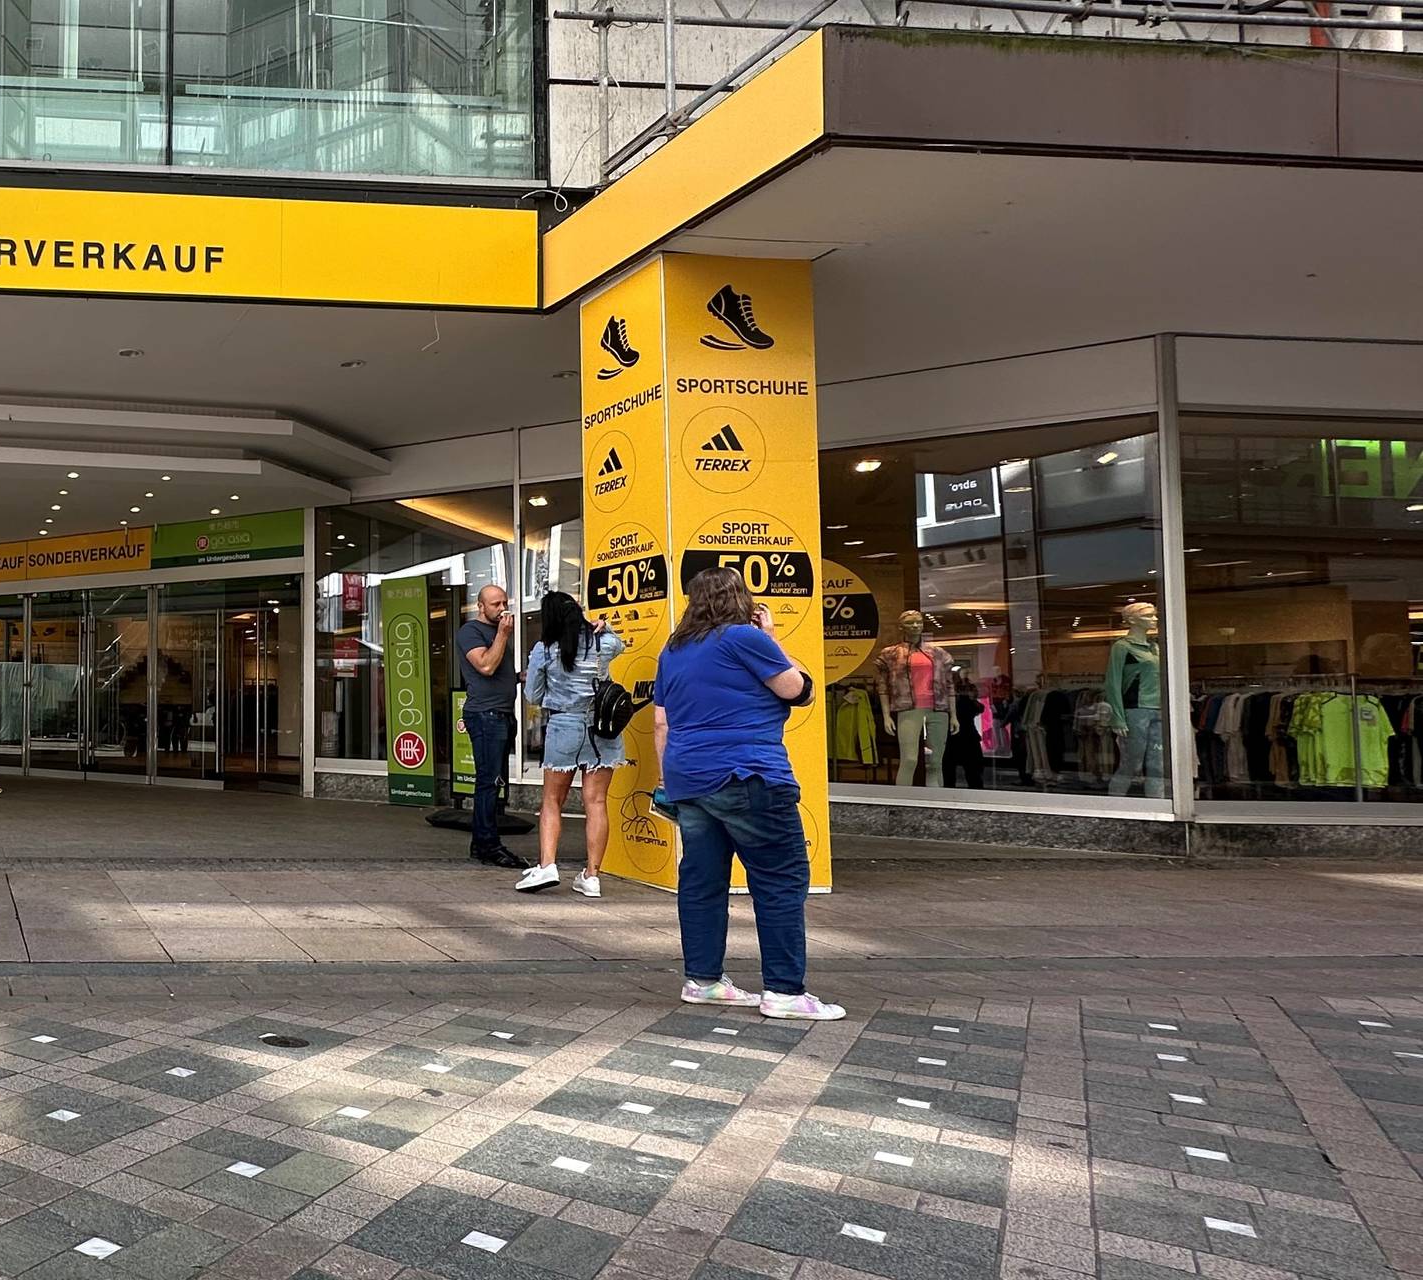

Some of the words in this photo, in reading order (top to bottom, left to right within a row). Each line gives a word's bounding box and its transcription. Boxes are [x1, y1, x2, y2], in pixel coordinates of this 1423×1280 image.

[676, 378, 809, 396] SPORTSCHUHE
[584, 384, 662, 430] SPORTSCHUHE
[694, 458, 752, 472] TERREX
[594, 475, 628, 497] TERREX
[722, 522, 769, 535] SPORT
[210, 536, 225, 549] go
[227, 532, 250, 544] asia
[609, 532, 639, 550] SPORT
[698, 534, 794, 546] SONDERVERKAUF
[28, 543, 146, 568] SONDERVERKAUF
[596, 541, 655, 562] SONDERVERKAUF
[597, 558, 656, 604] -50%
[392, 622, 414, 679] asia
[397, 688, 423, 727] go
